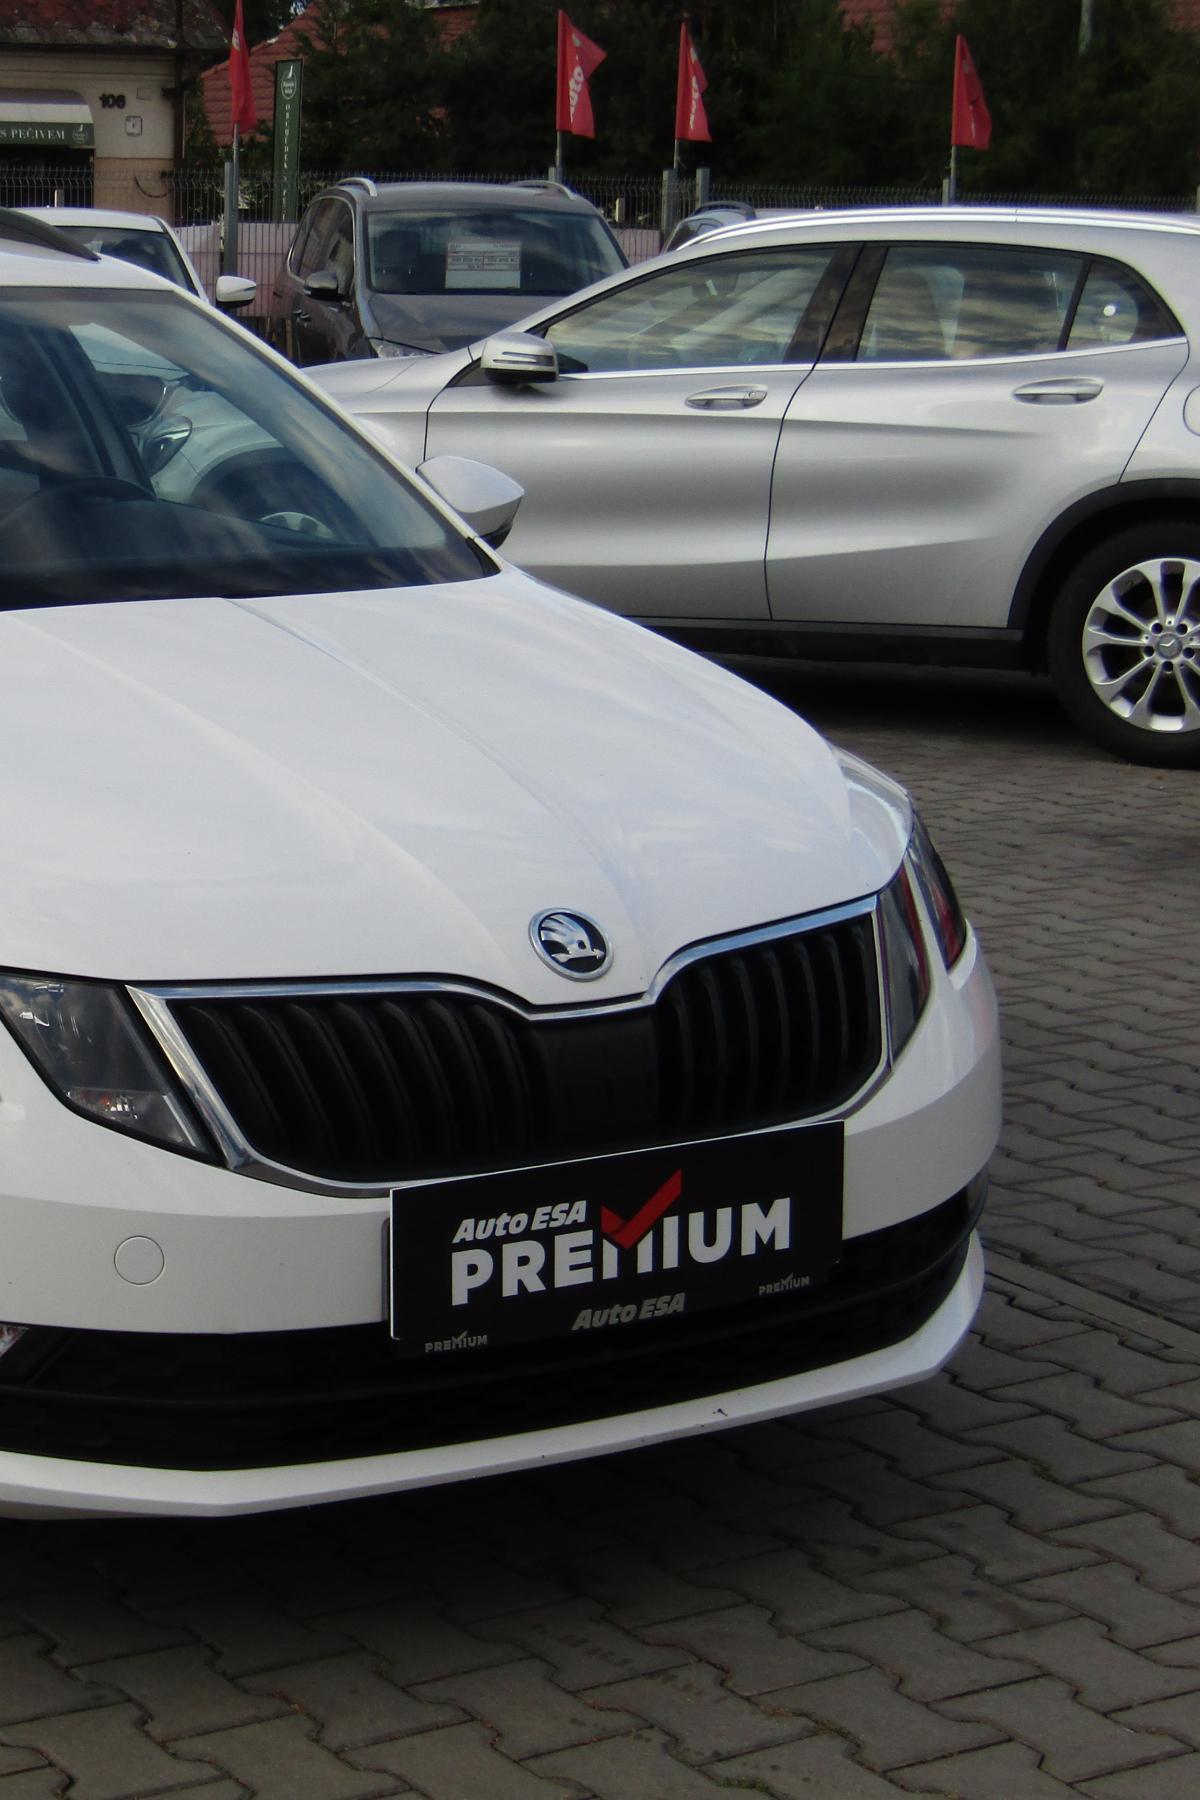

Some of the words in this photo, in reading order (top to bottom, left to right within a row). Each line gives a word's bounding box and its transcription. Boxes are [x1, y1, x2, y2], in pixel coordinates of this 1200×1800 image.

[0, 127, 8, 138] S
[11, 126, 65, 140] PEČIVEM
[452, 1210, 527, 1243] Auto
[531, 1200, 587, 1231] ESA
[451, 1190, 791, 1306] PREMIUM
[758, 1273, 810, 1296] PREMIUM
[571, 1303, 637, 1331] Auto
[638, 1293, 686, 1321] ESA
[425, 1330, 488, 1353] PREMIUM
